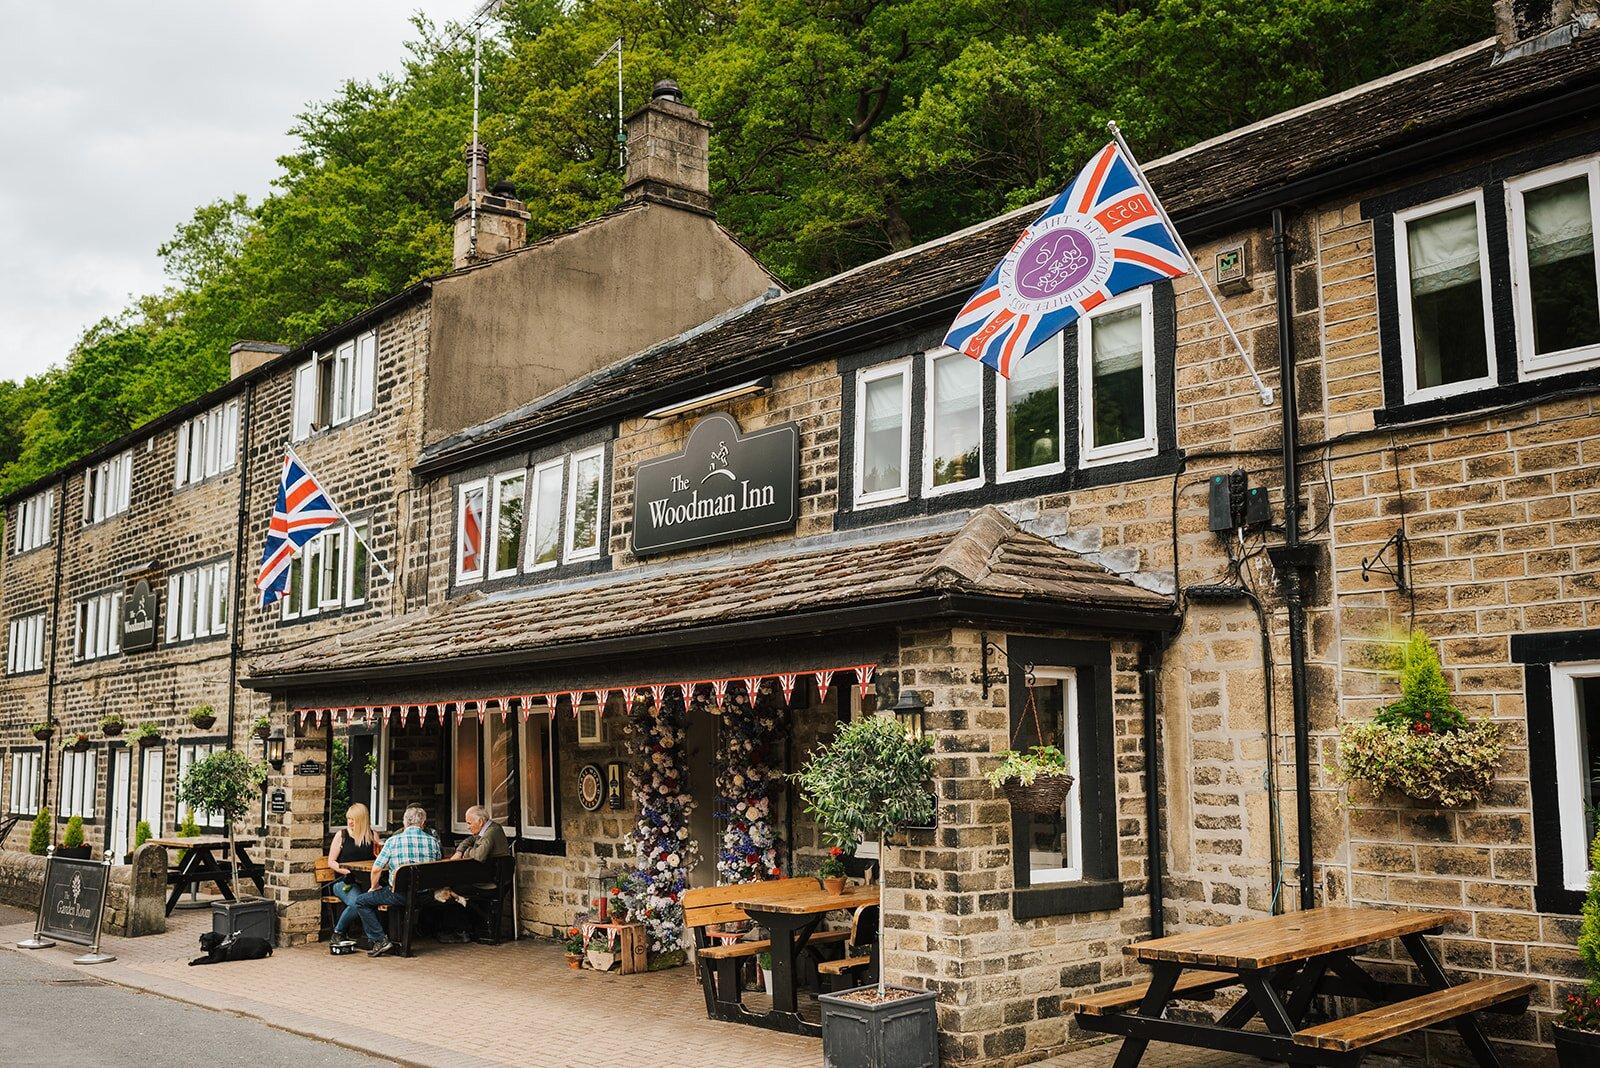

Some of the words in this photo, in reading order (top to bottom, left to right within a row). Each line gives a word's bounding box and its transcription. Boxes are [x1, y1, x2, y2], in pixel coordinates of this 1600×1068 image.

[670, 475, 690, 493] The
[648, 490, 735, 528] Woodman
[740, 480, 775, 511] Inn
[57, 900, 75, 915] Garden
[76, 903, 90, 918] Room
